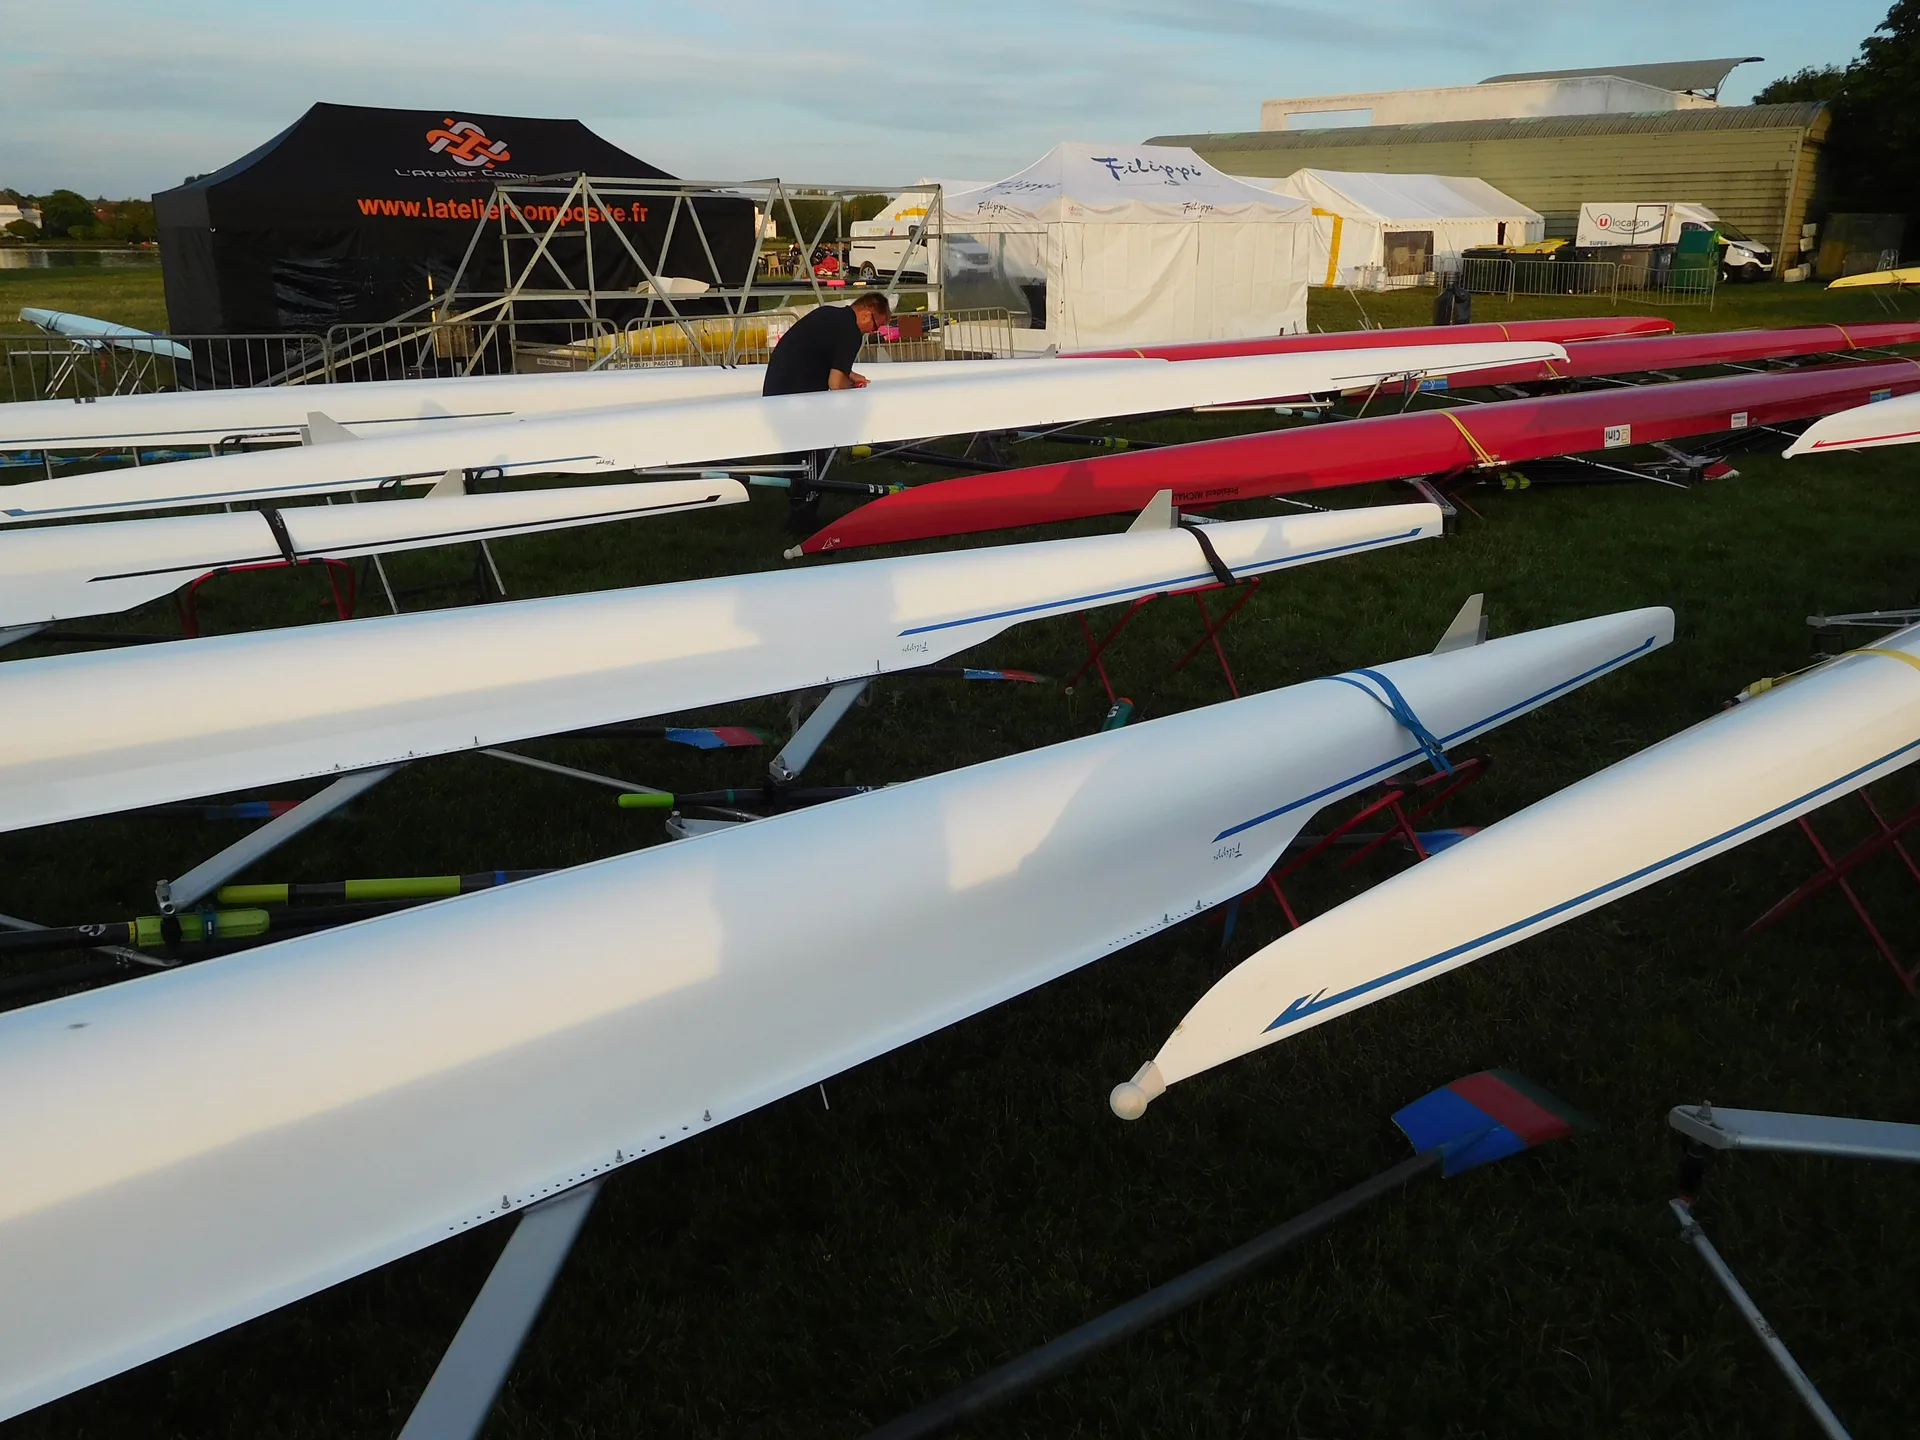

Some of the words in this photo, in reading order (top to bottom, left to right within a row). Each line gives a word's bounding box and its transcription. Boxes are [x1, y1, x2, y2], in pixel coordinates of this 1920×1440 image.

[1091, 157, 1202, 182] Filippi
[977, 201, 1008, 215] Filippi
[1182, 202, 1214, 214] Filippi
[1599, 218, 1608, 227] U
[1612, 218, 1650, 227] location
[1605, 429, 1621, 443] Cini
